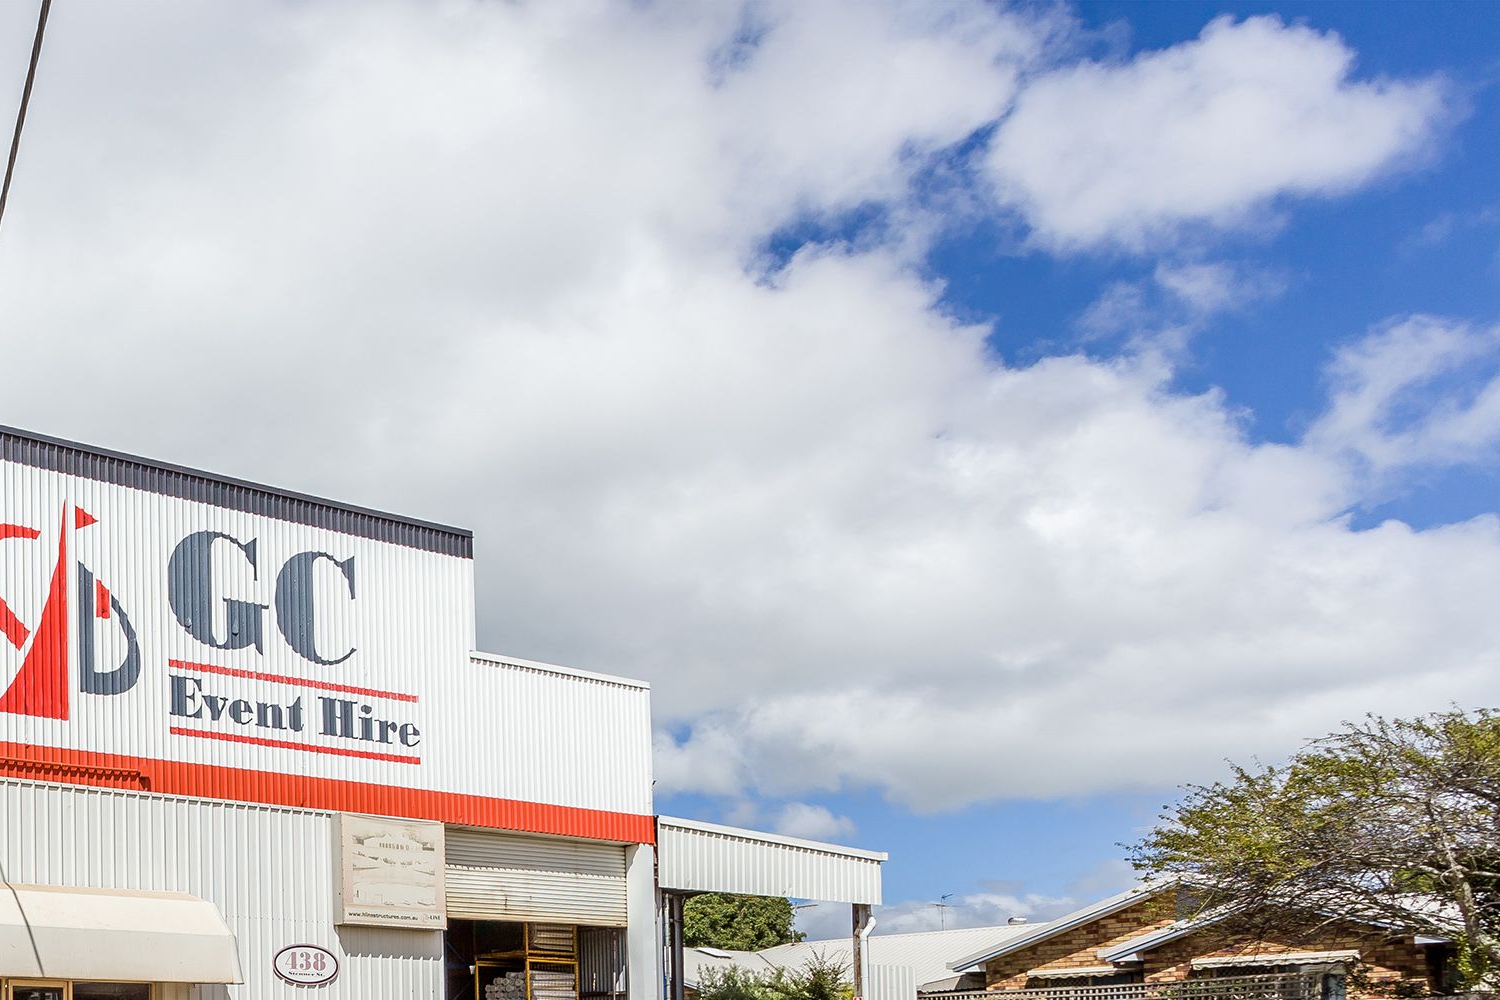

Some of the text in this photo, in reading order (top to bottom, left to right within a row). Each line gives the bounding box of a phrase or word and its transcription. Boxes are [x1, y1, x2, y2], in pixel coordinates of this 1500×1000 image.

[167, 530, 356, 667] GC
[169, 674, 421, 748] Event Hire
[285, 951, 326, 971] 438
